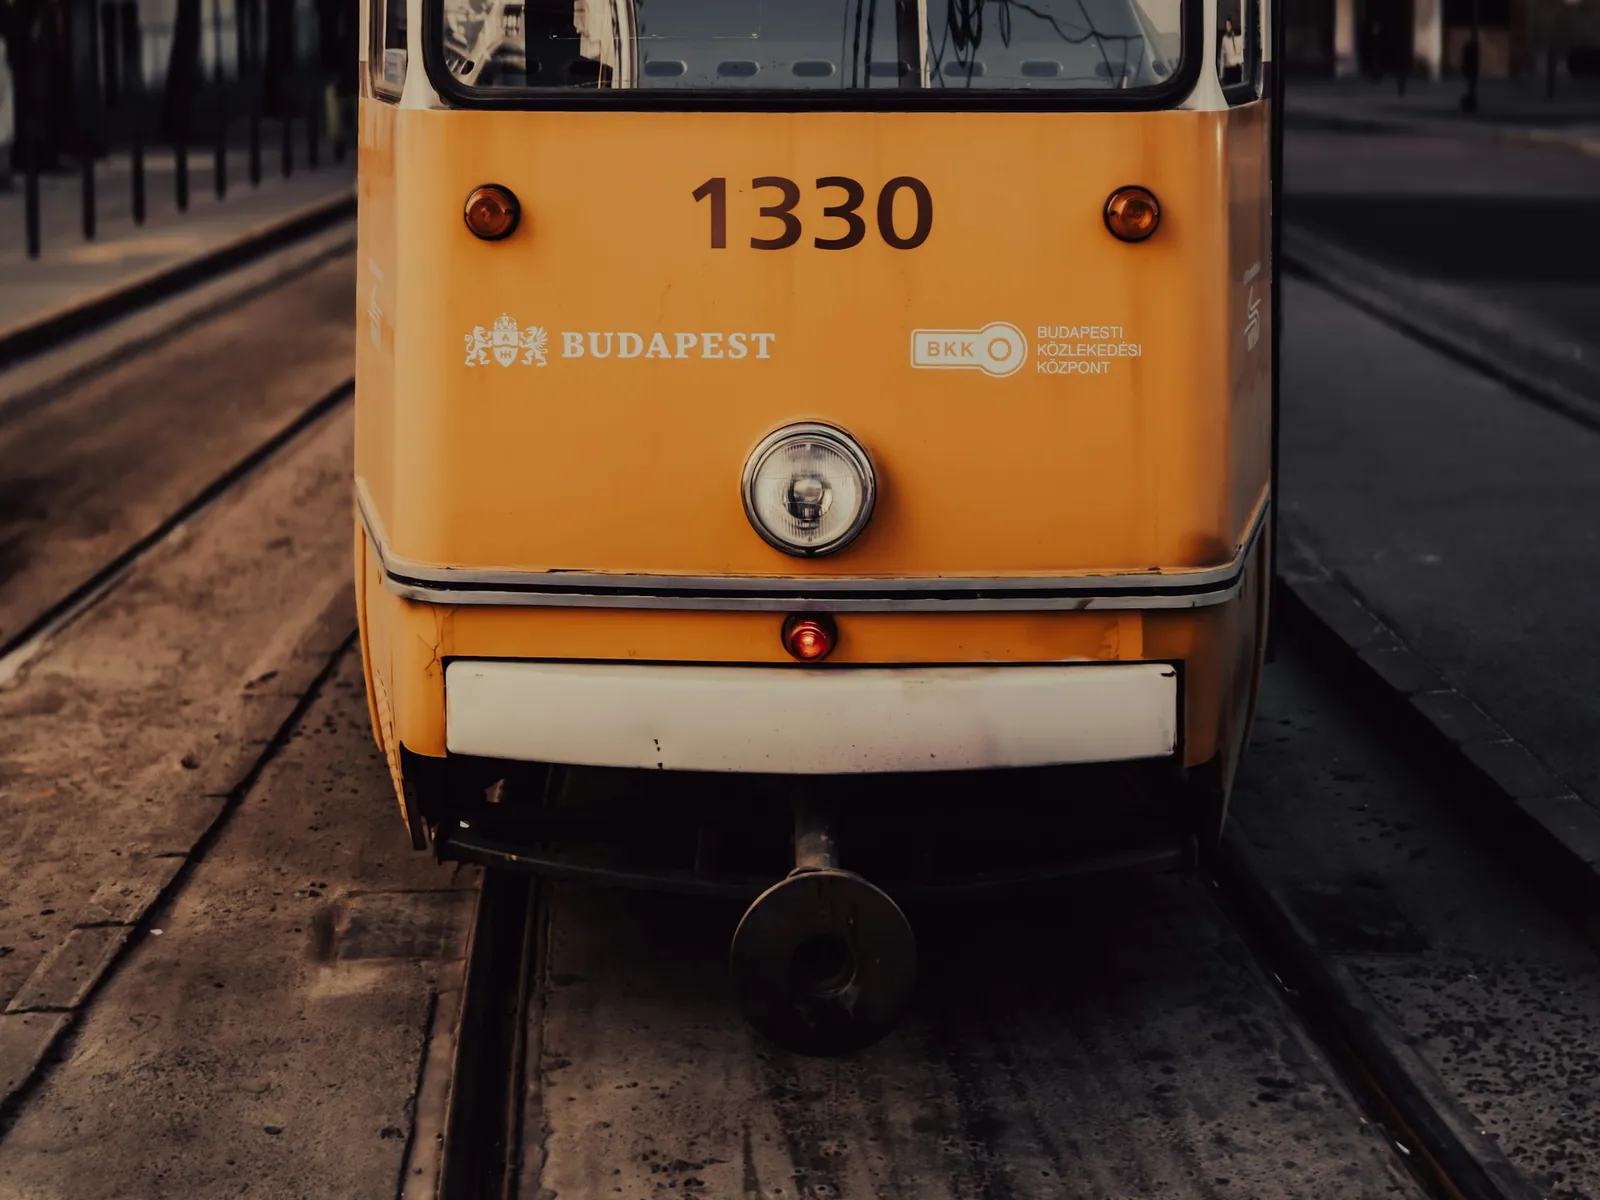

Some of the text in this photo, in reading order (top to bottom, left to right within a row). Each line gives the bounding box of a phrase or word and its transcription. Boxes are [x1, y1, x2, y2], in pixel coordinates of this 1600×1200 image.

[691, 175, 934, 251] 1330
[1037, 325, 1123, 339] BUDAPESTI
[561, 331, 776, 359] BUDAPEST
[927, 340, 975, 358] BKK
[1037, 341, 1142, 357] KÖZLEKEDÉSI
[1037, 358, 1111, 375] KÖZPONT
